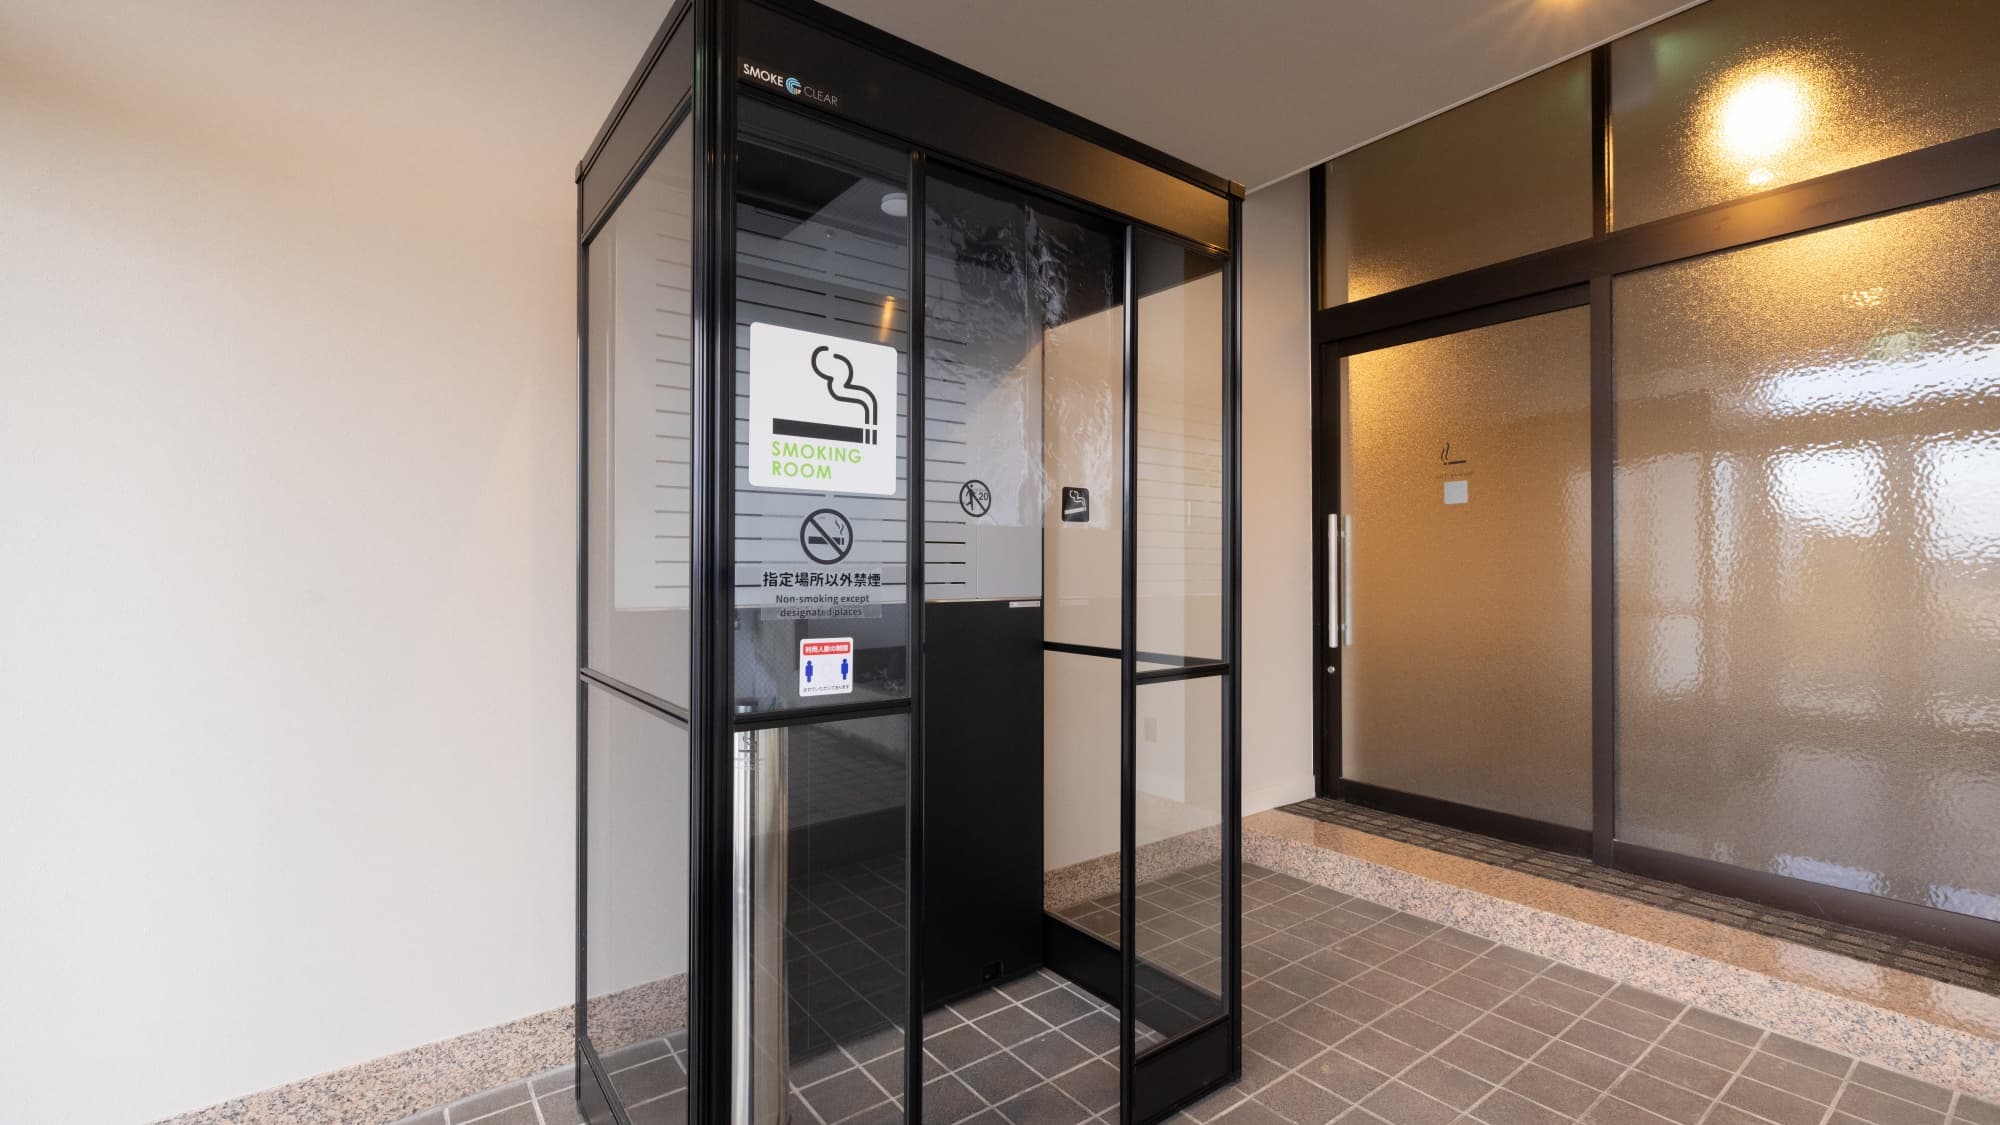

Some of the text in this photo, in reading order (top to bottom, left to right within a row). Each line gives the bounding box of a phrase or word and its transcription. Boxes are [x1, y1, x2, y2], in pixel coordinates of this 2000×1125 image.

[743, 63, 838, 106] SMOKE CLEAR
[771, 440, 862, 463] SMOKING
[772, 460, 832, 480] ROOM
[978, 492, 988, 501] 20
[763, 571, 881, 588] 指定場所以外禁煙
[776, 594, 870, 605] Non-smoking except
[780, 607, 863, 619] designated places
